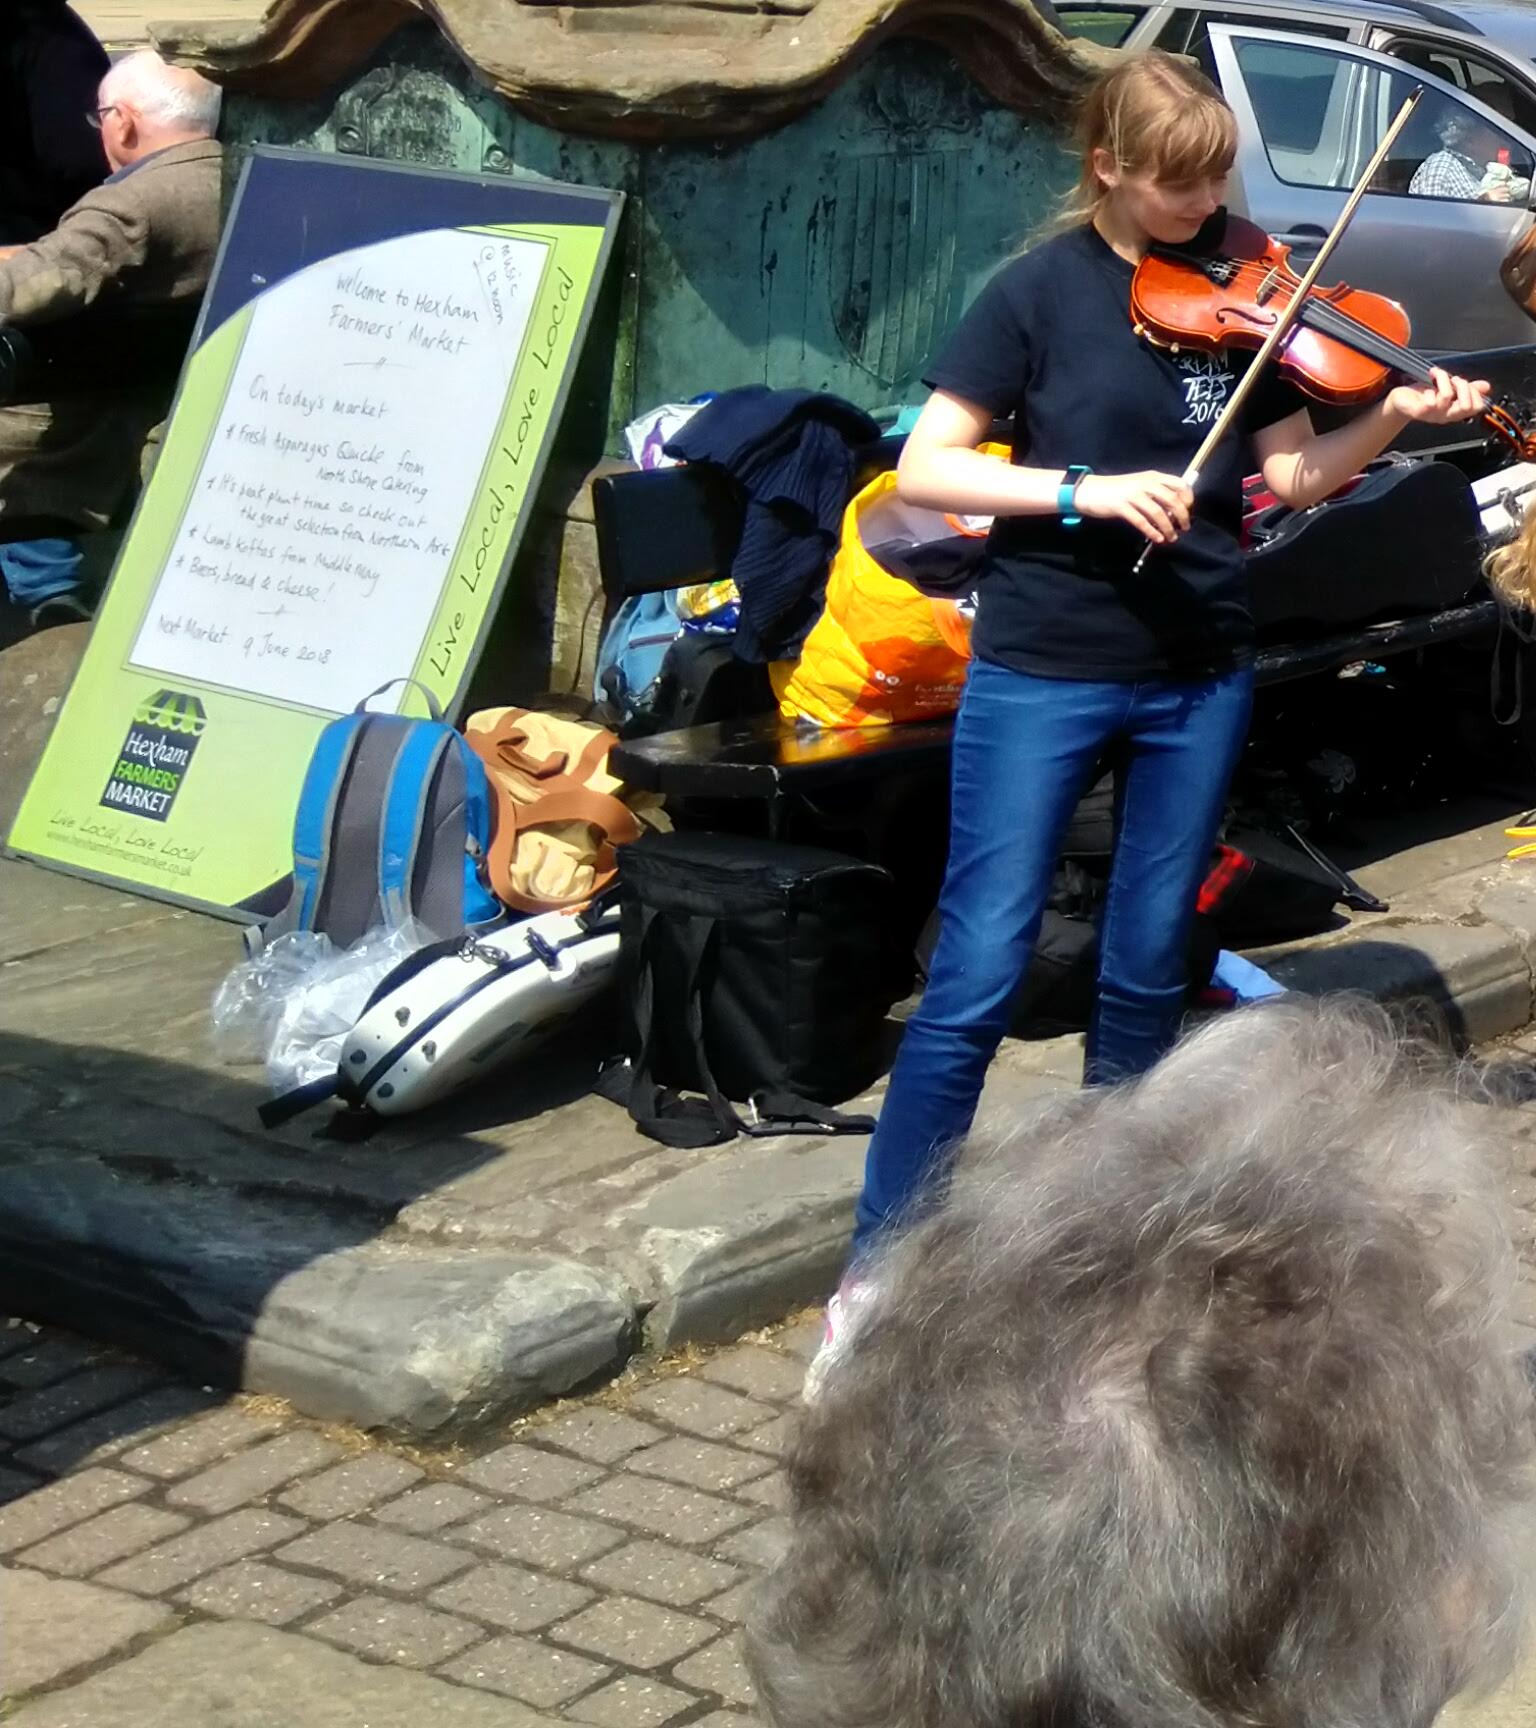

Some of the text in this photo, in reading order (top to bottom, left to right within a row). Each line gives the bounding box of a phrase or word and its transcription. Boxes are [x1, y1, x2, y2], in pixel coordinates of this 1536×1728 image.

[396, 290, 410, 307] to
[414, 293, 479, 323] Hexham
[408, 323, 471, 354] Market
[249, 375, 268, 401] On
[332, 396, 390, 420] market
[239, 424, 267, 447] Fresh
[397, 449, 425, 476] from
[430, 611, 465, 677] Live
[503, 387, 540, 466] Love
[532, 266, 576, 370] Local
[357, 503, 394, 524] check
[398, 515, 428, 529] out
[257, 632, 290, 658] June
[295, 645, 333, 665] 2018
[125, 731, 189, 767] Hexham
[114, 759, 180, 792] FARMERS
[105, 780, 172, 813] MARKET
[50, 808, 75, 829] Live
[125, 827, 157, 851] Love
[160, 837, 206, 862] Local
